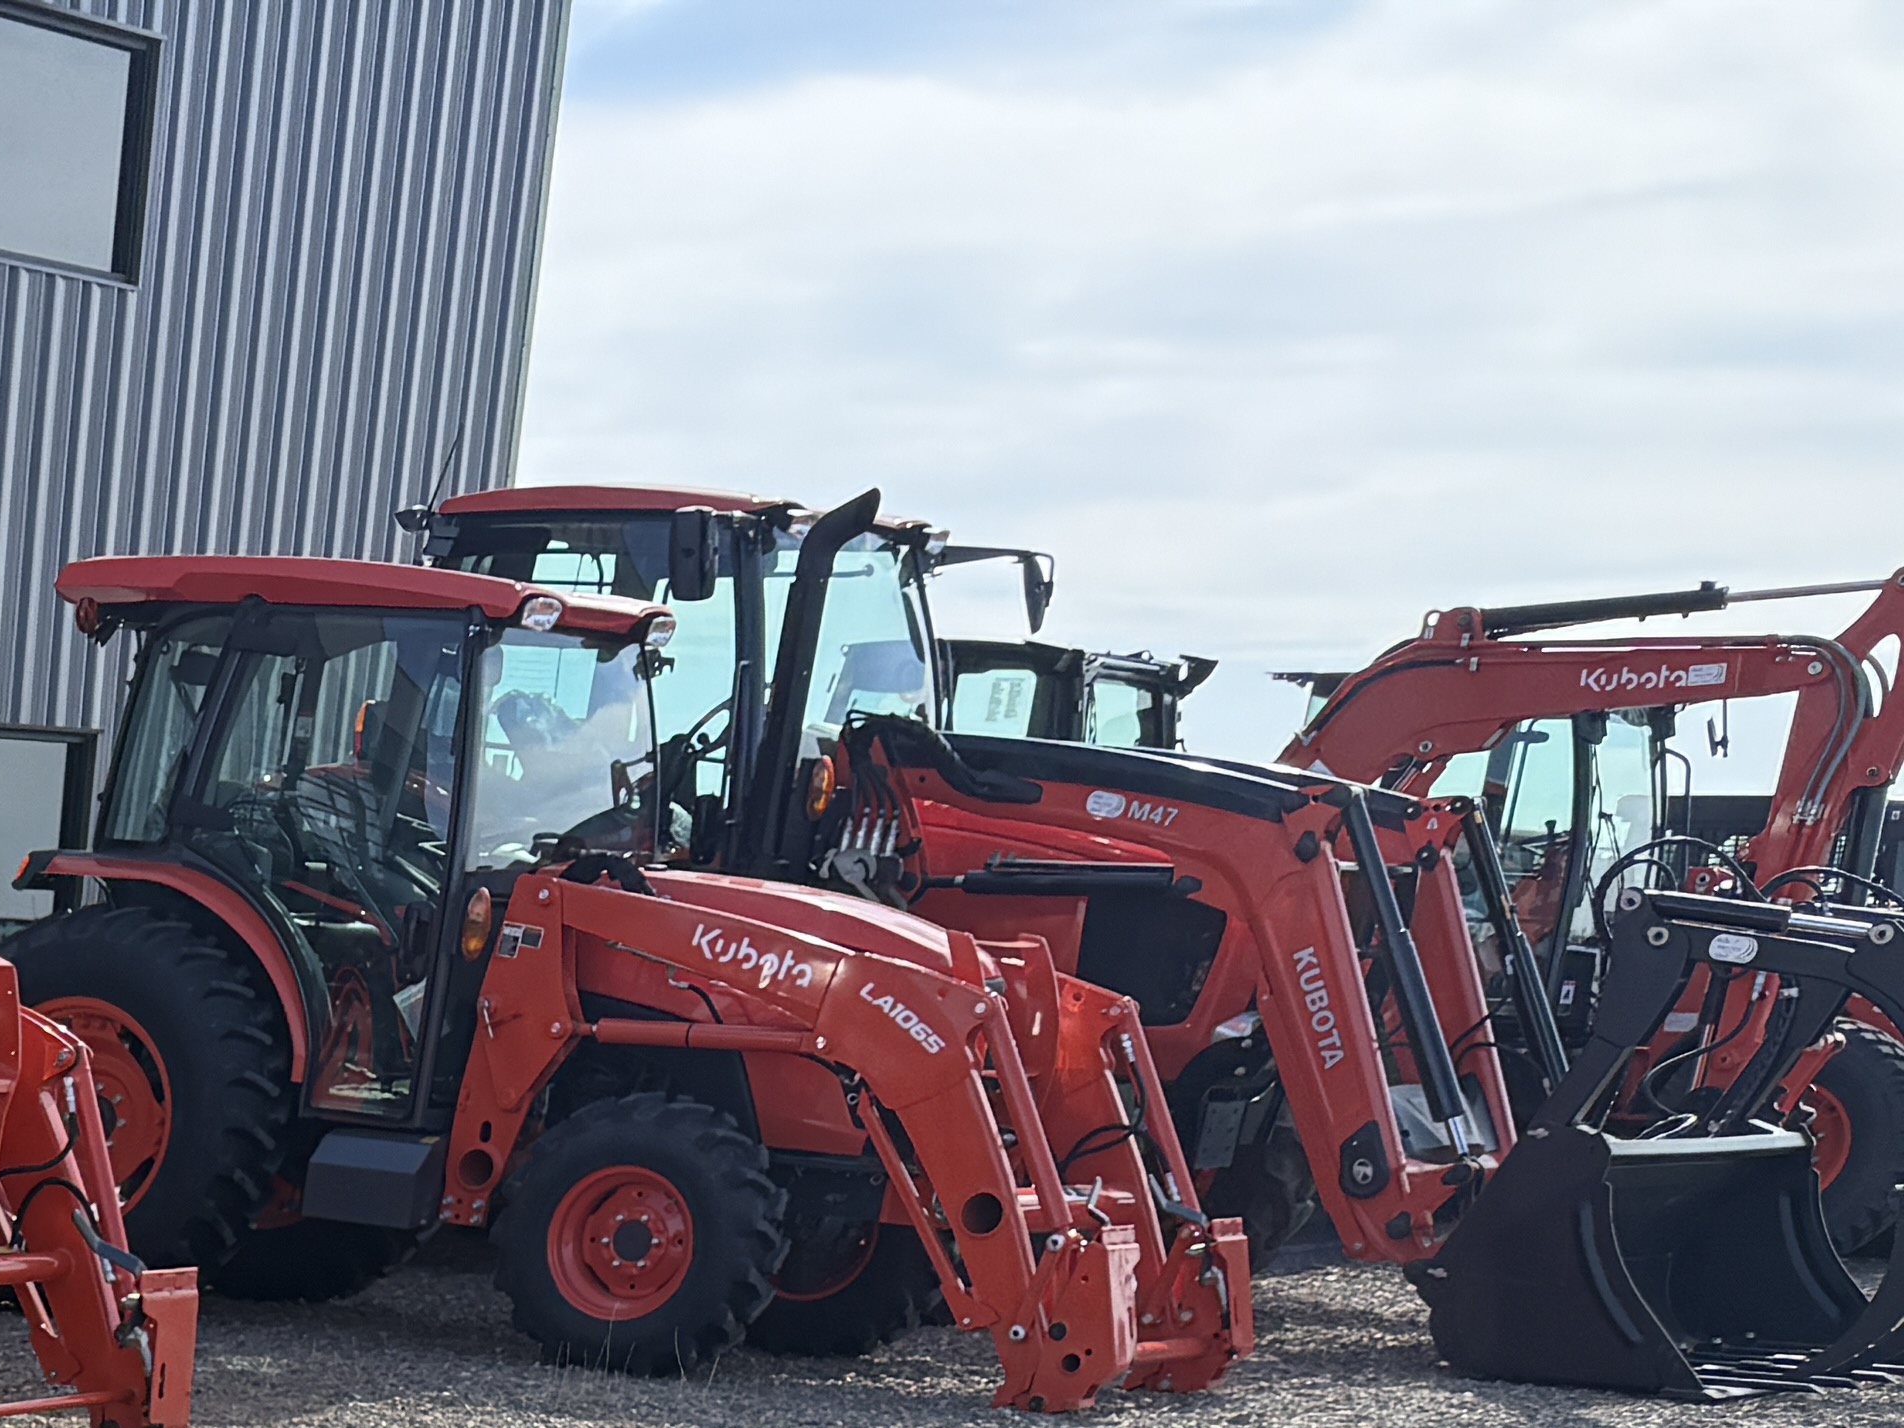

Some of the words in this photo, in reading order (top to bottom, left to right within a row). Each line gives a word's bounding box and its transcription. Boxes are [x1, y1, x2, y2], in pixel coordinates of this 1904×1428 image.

[1580, 665, 1687, 692] Kubota
[1128, 800, 1179, 827] M47
[692, 924, 813, 988] Kubota
[860, 983, 946, 1054] LA1065
[1293, 947, 1344, 1070] KUBOTA
